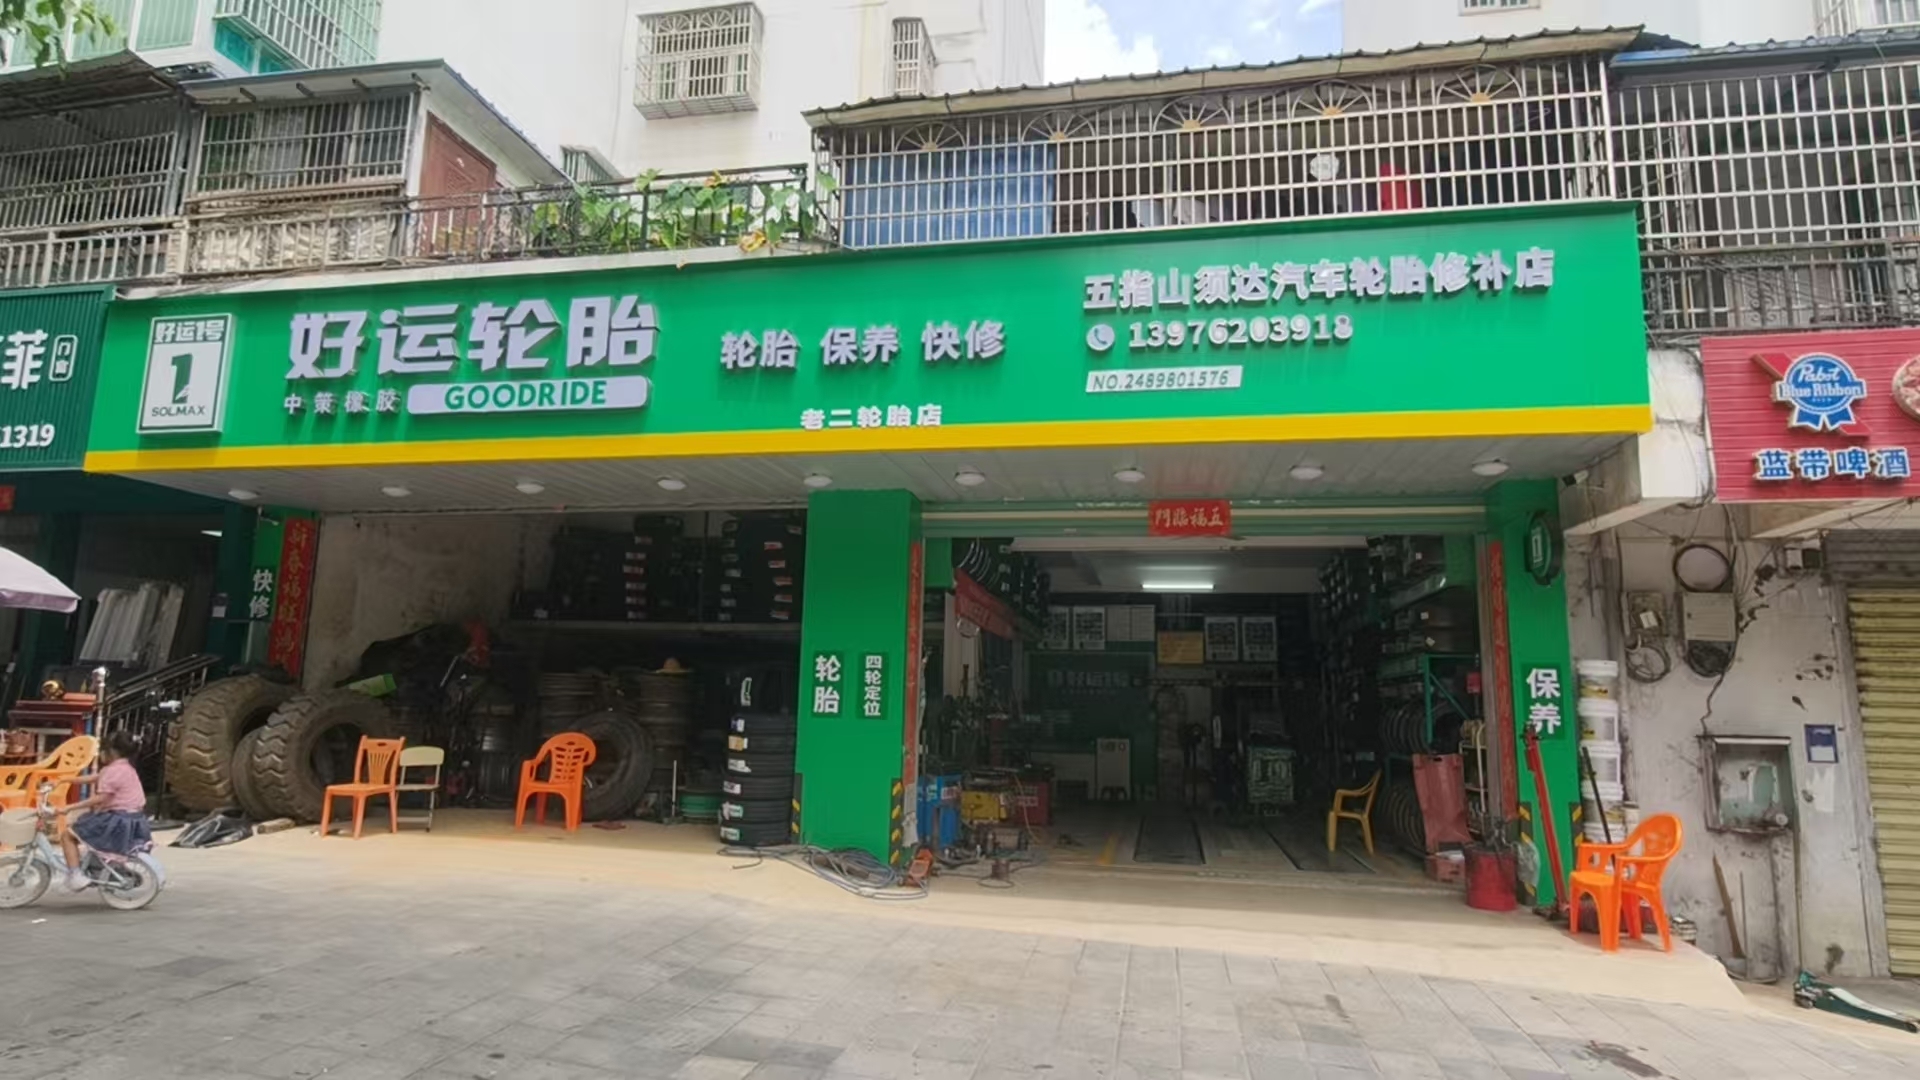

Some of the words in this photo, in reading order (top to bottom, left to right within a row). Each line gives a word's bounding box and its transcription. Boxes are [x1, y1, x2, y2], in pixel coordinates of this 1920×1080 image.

[1083, 247, 1555, 310] 五指山须达汽车轮胎修补店
[154, 319, 225, 343] 好运1号
[286, 295, 659, 380] 好运轮胎
[720, 330, 800, 369] 轮胎
[820, 324, 900, 365] 保养
[921, 320, 1006, 362] 快修
[1129, 313, 1353, 348] 13976203918
[0, 329, 49, 390] 菲
[444, 381, 607, 410] GOODRIDE
[1092, 370, 1230, 390] NO.2489801576
[151, 405, 206, 417] SOLMAX
[284, 388, 400, 415] 中策橡胶
[800, 403, 942, 430] 老二轮胎店
[0, 423, 56, 448] 1319
[1756, 446, 1911, 480] 蓝带啤酒
[250, 568, 273, 618] 快修
[813, 654, 842, 714] 轮胎
[863, 655, 883, 717] 四轮定位
[1526, 667, 1561, 735] 保养
